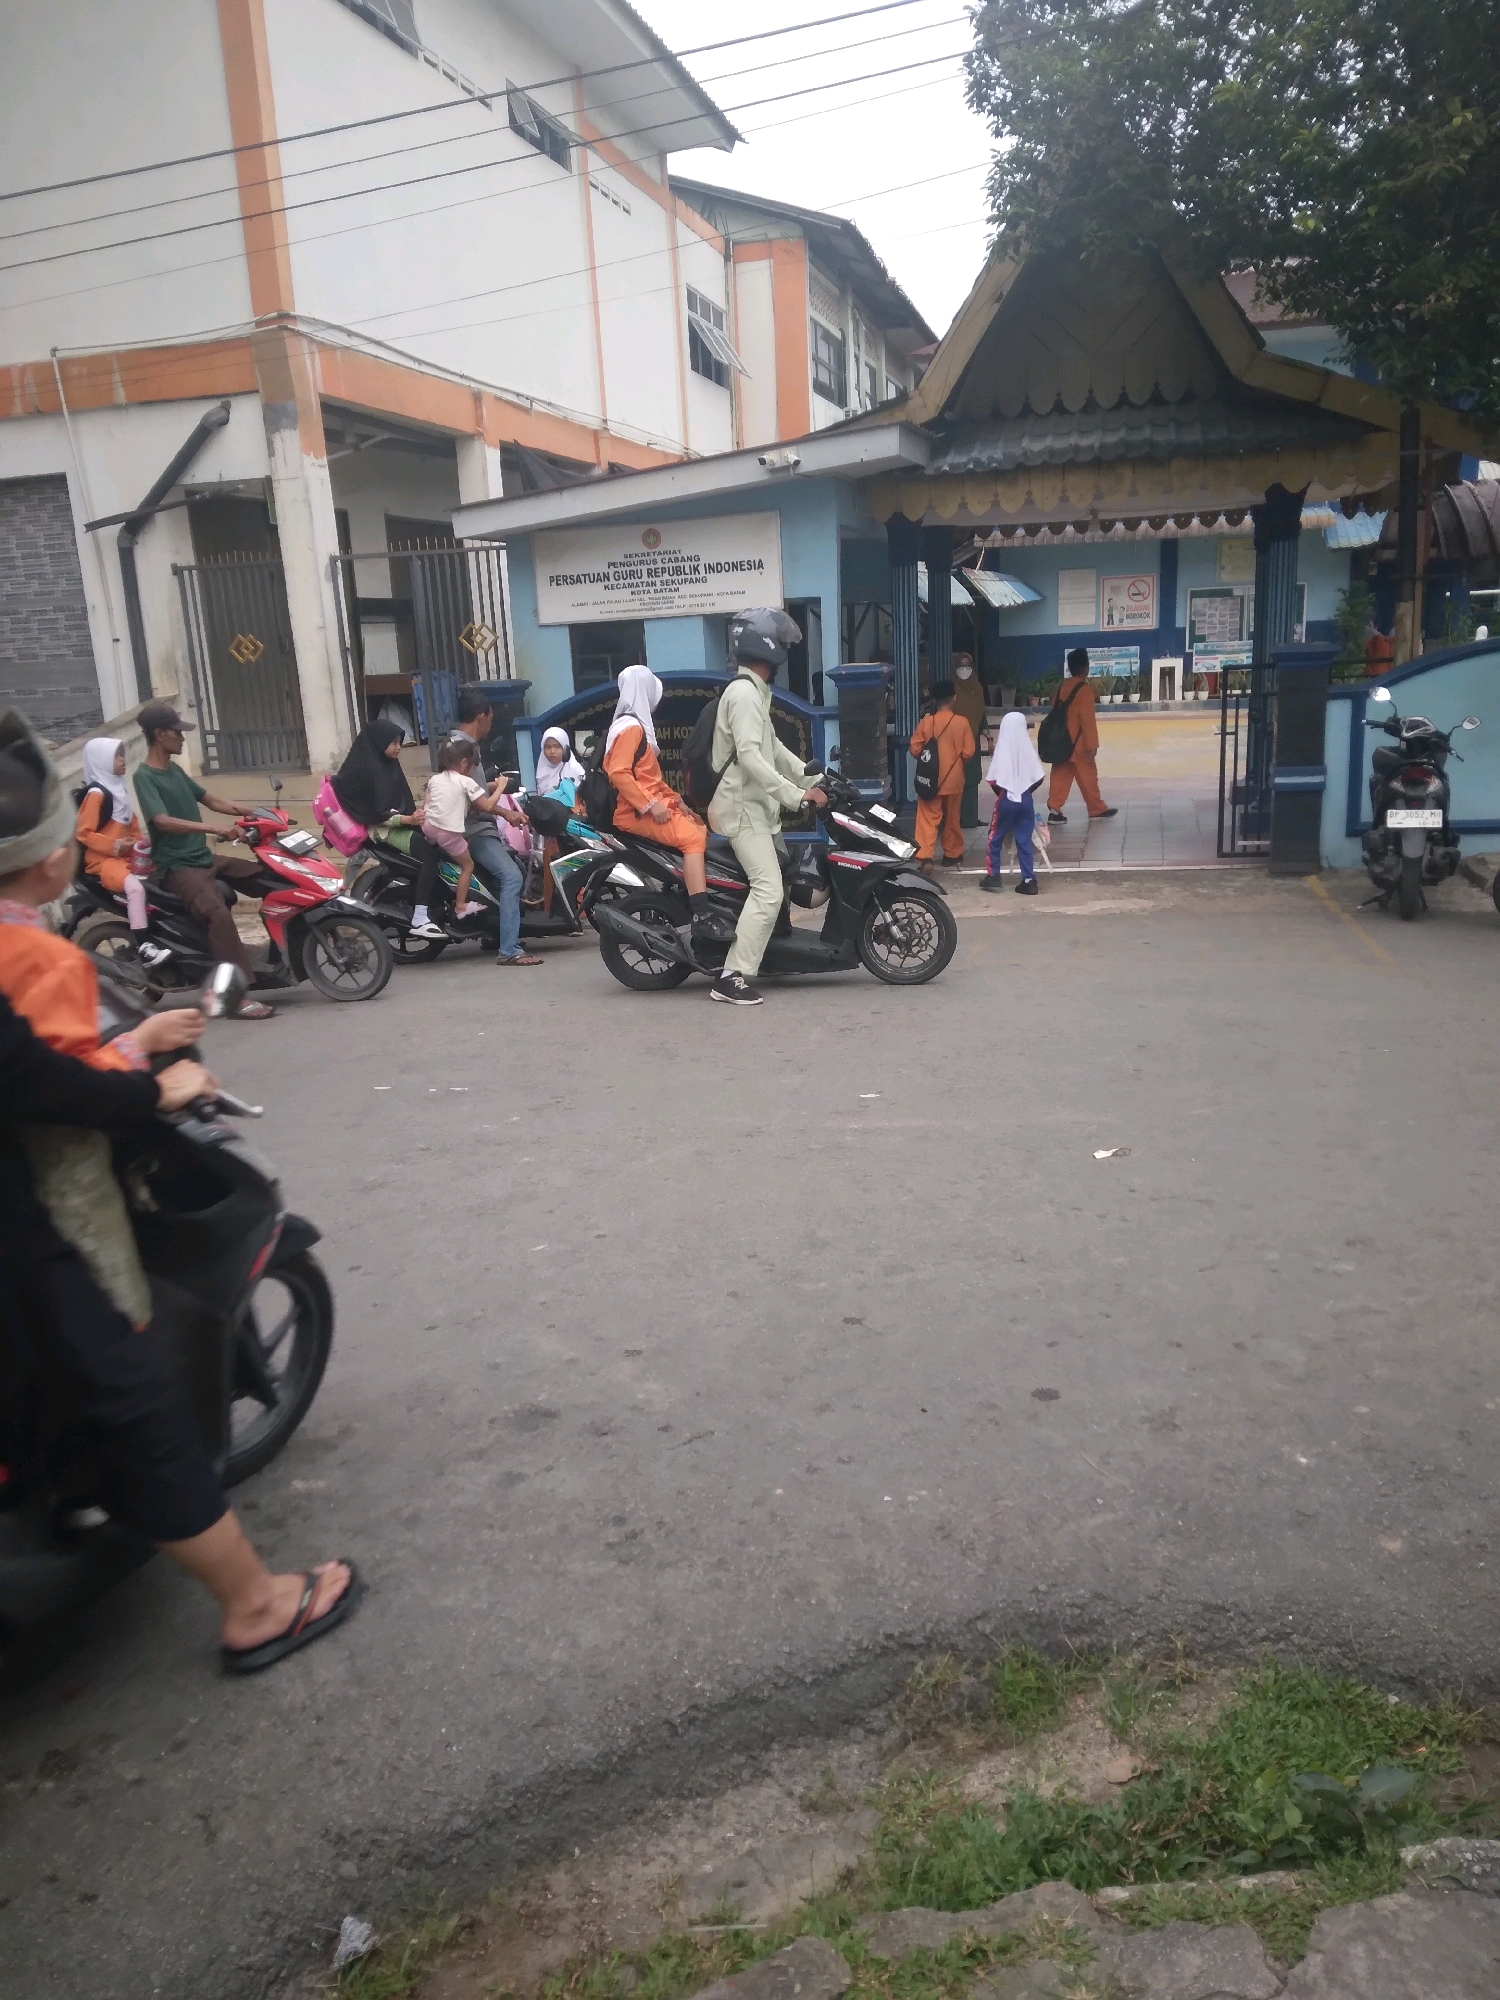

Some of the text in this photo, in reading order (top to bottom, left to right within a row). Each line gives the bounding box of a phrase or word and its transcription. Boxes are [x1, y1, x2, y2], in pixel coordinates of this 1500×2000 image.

[623, 549, 682, 559] SEKRETARIAT
[607, 554, 701, 569] PENGURUS CABANG
[549, 558, 765, 587] PERSATUAN GURU REPUBLIK INDONESIA
[603, 575, 708, 591] KECAMATAN SEKUPANG
[653, 587, 680, 595] BATAM
[1125, 611, 1151, 620] MEROKOK
[837, 861, 863, 871] HONDA
